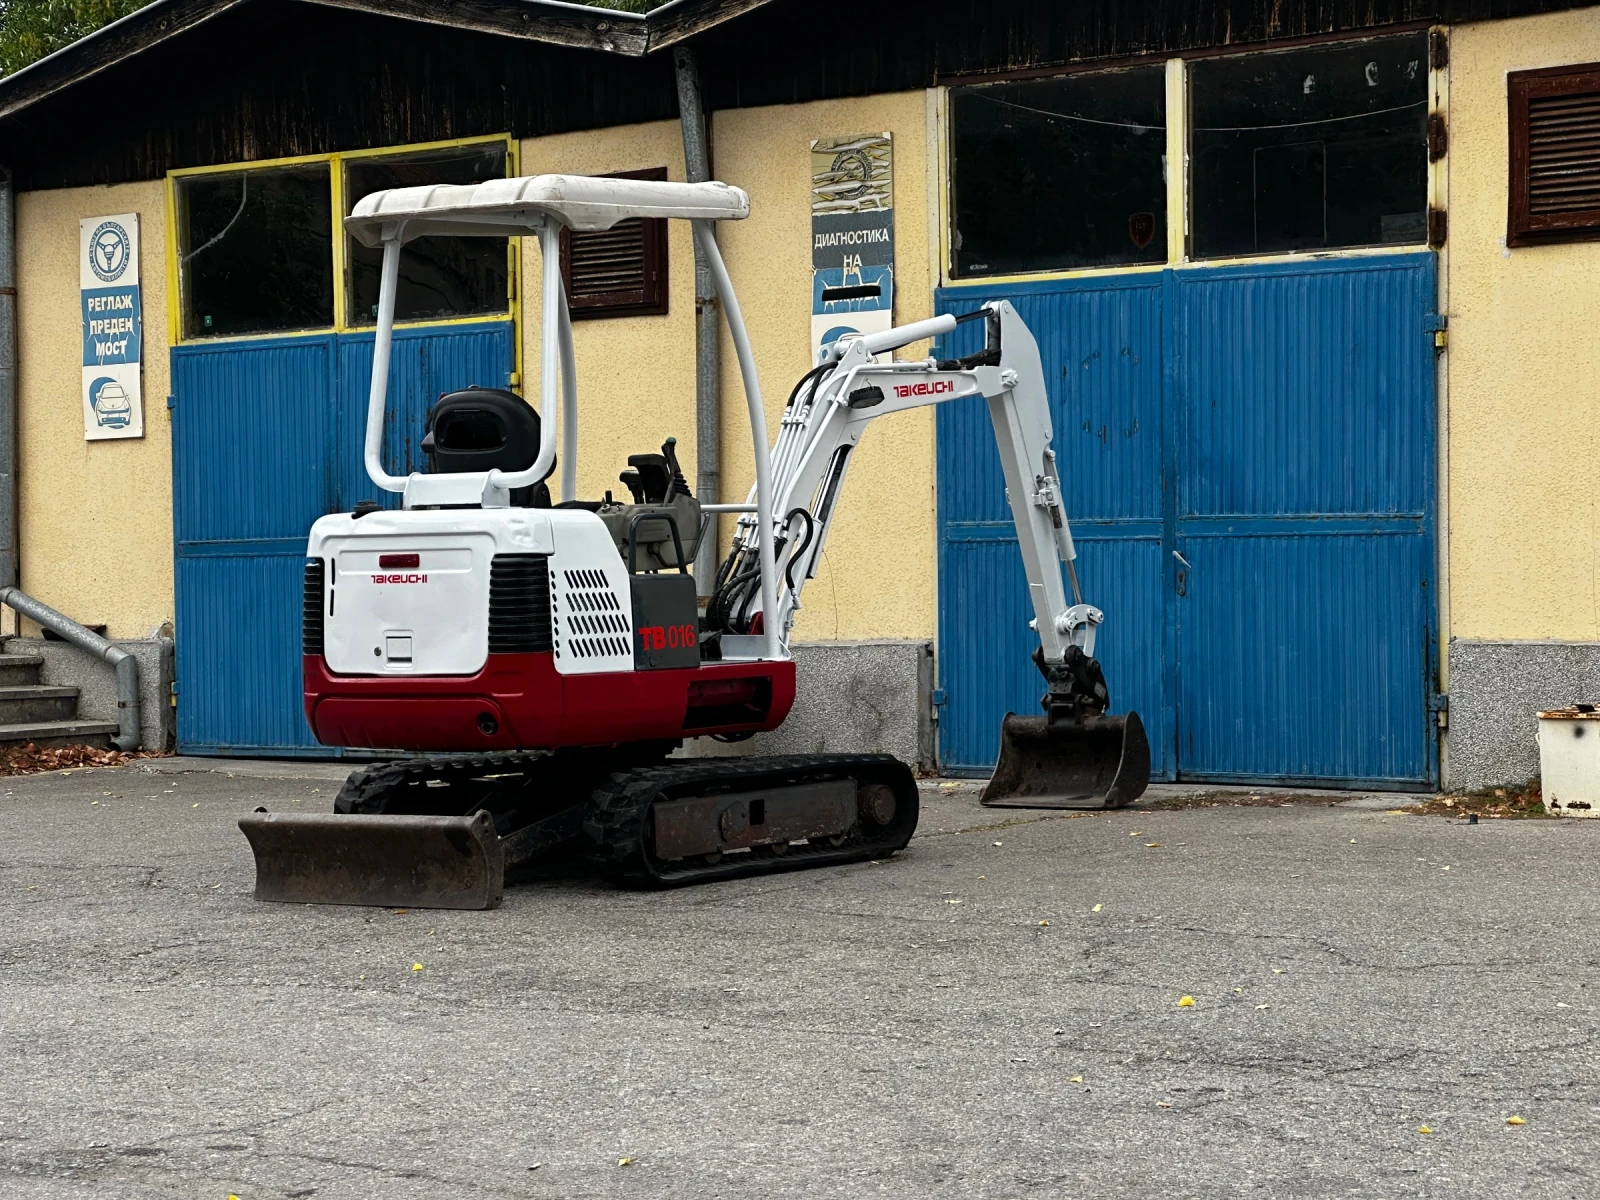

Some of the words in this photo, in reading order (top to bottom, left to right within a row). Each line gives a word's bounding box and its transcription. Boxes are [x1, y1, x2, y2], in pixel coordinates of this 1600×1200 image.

[814, 228, 890, 249] ДИАГНОСТИКА
[843, 253, 863, 267] НА
[88, 294, 133, 312] РЕГЛАЖ
[90, 317, 133, 335] ПРЕДЕН
[95, 340, 128, 356] МОСТ
[893, 380, 954, 398] TAKEUCHI
[370, 574, 428, 584] TAKEUCHI
